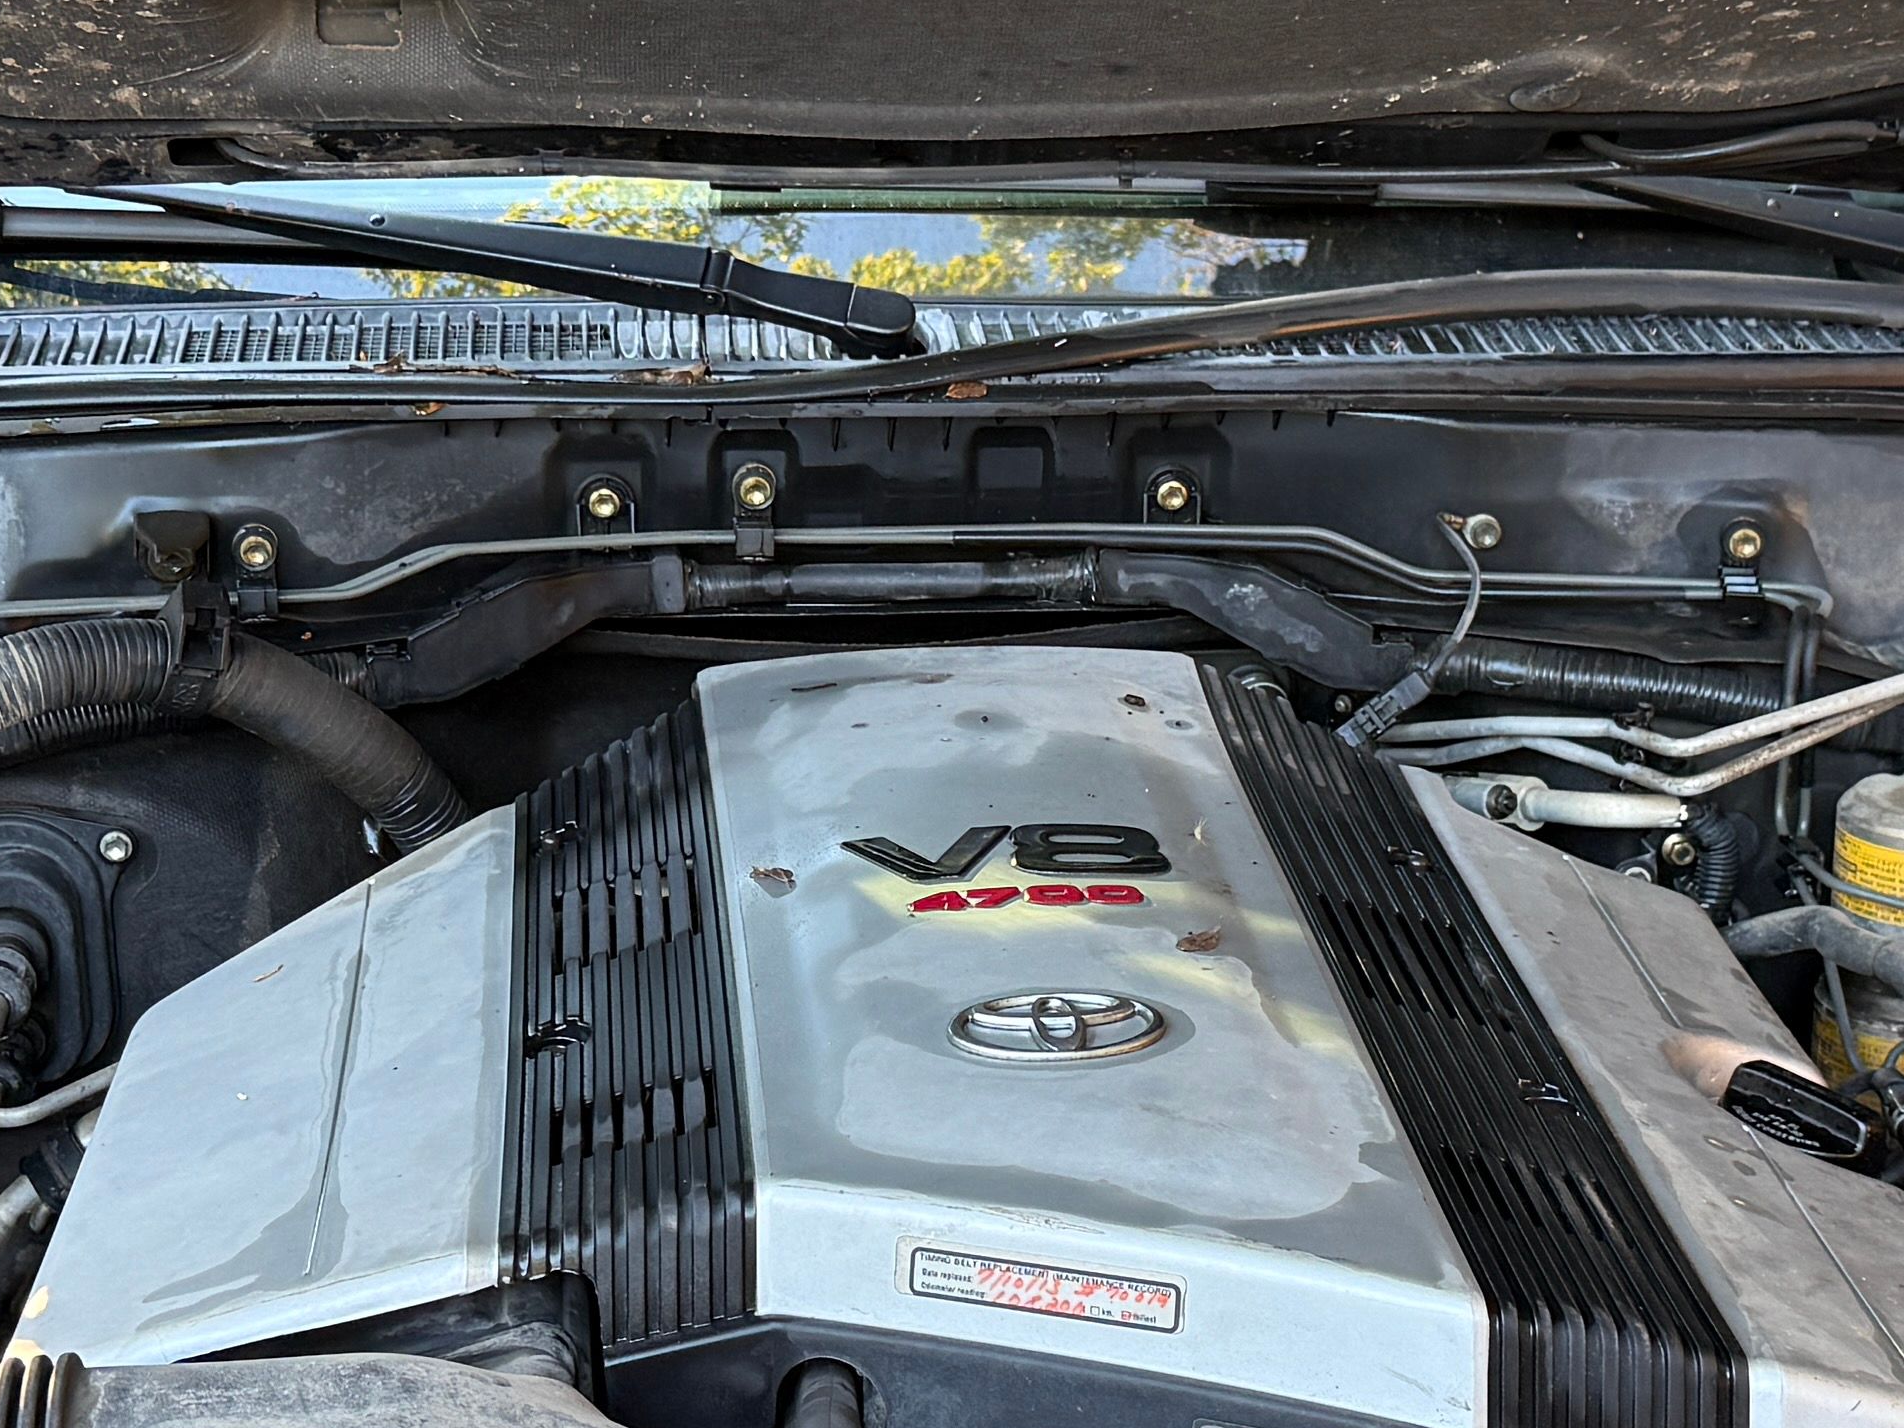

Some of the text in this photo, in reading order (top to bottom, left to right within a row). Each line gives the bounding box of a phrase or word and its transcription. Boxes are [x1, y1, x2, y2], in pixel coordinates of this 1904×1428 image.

[840, 824, 1172, 883] V8
[907, 884, 1145, 913] 4700
[954, 1257, 977, 1268] BELT
[980, 1261, 1049, 1279] REPLACEMENT
